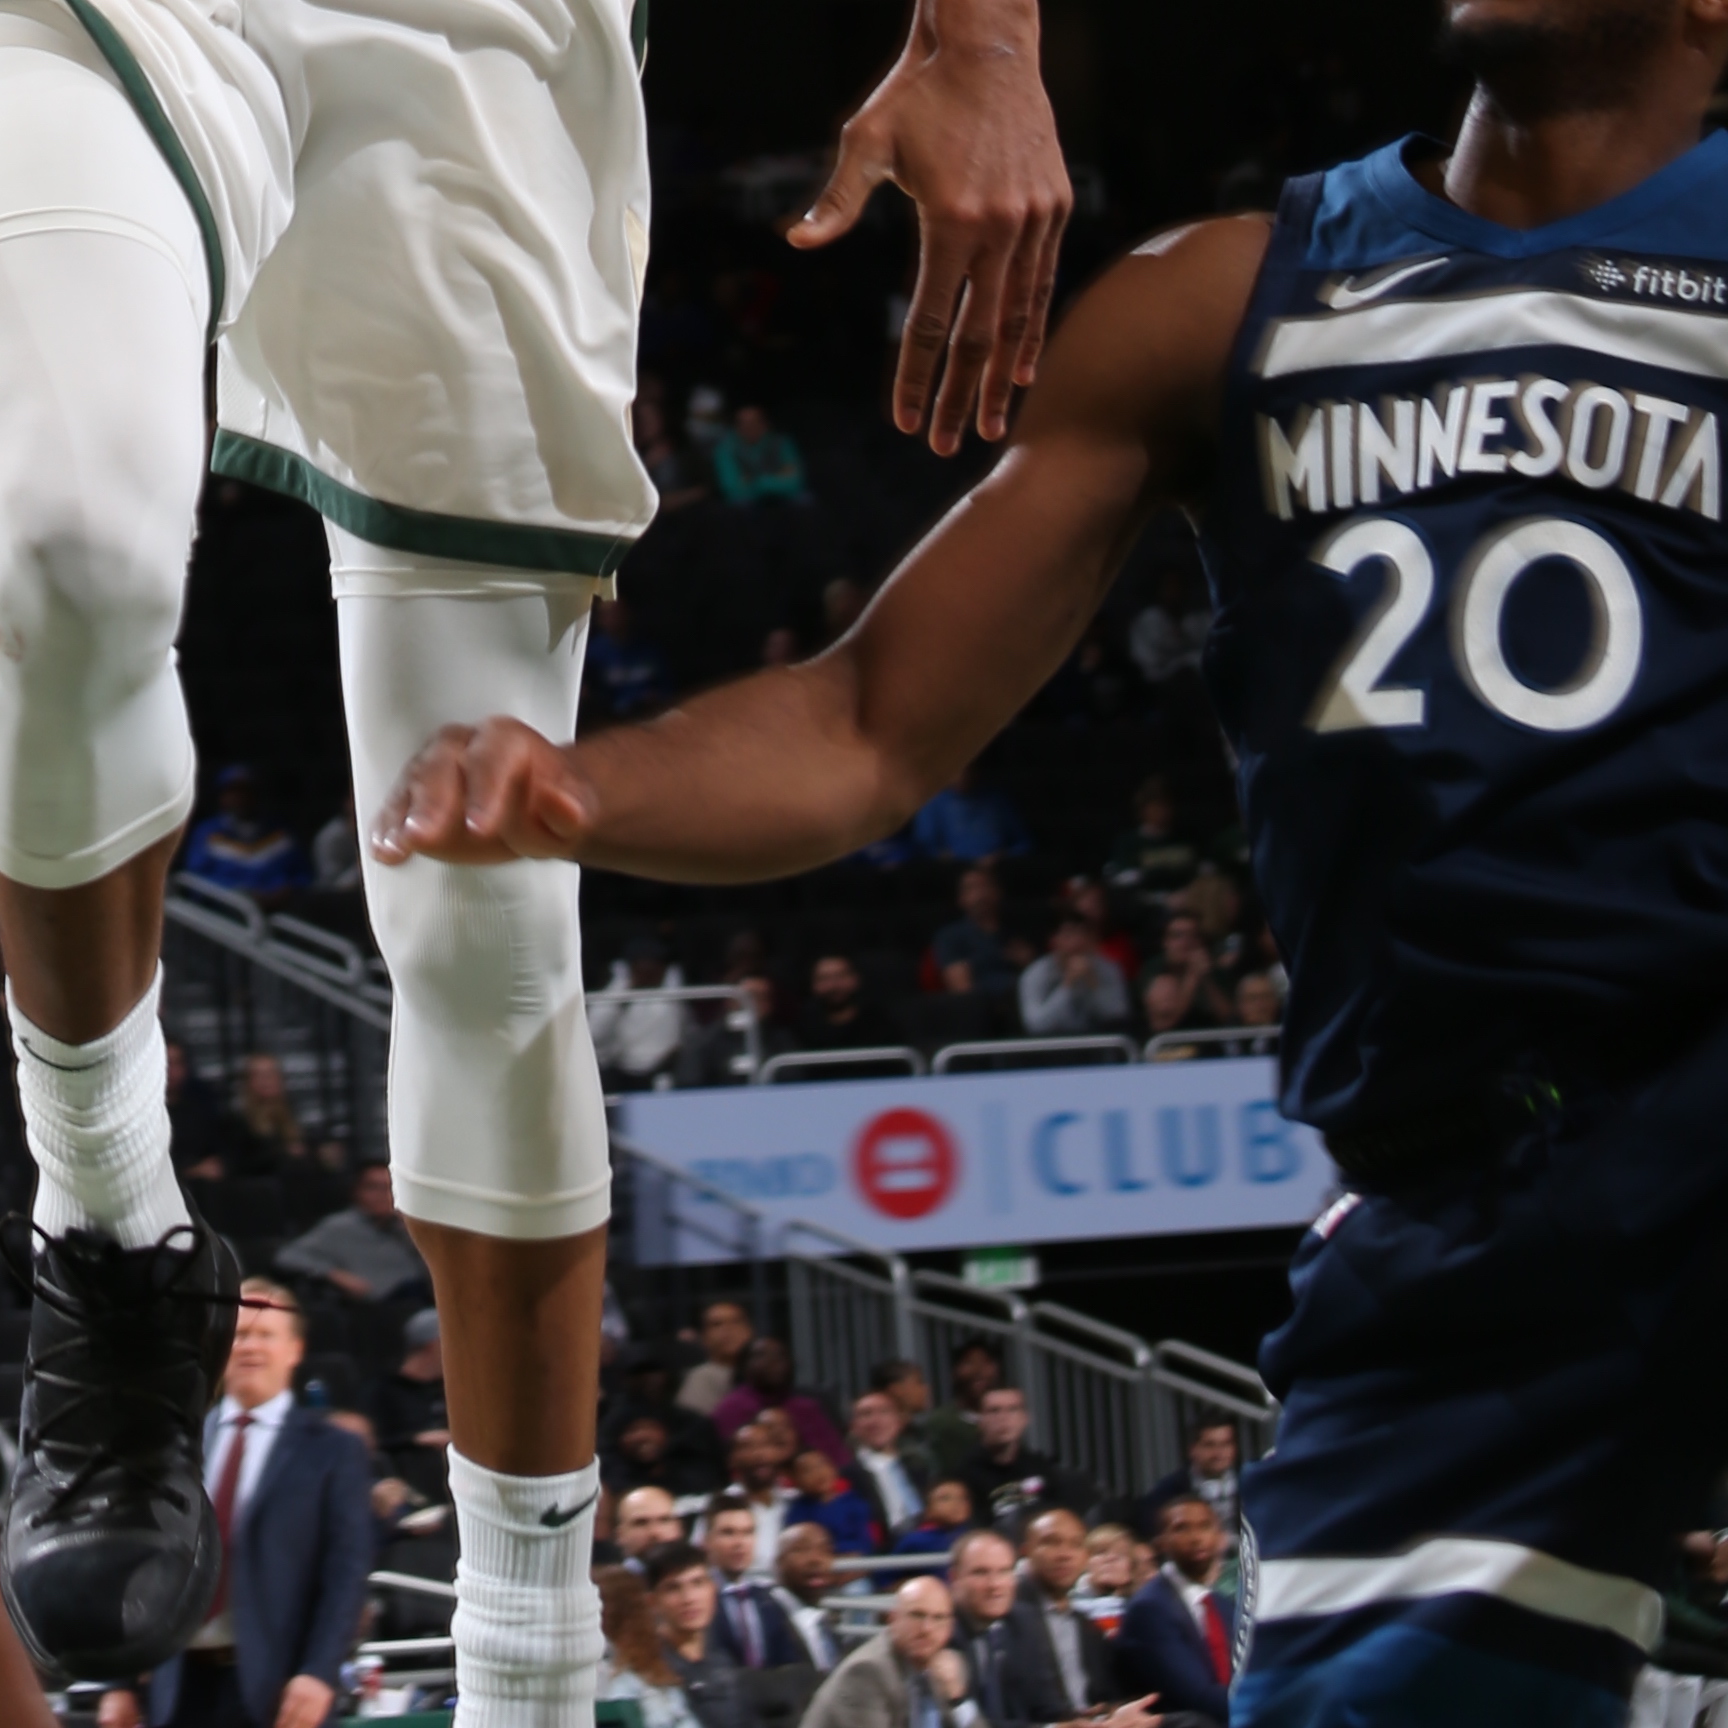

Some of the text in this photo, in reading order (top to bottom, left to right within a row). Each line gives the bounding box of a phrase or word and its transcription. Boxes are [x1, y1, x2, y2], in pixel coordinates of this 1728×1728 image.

[1633, 265, 1727, 304] fitbit
[1262, 377, 1722, 522] MINNESOTA
[1308, 516, 1643, 734] 20
[1030, 1098, 1308, 1196] CLUB
